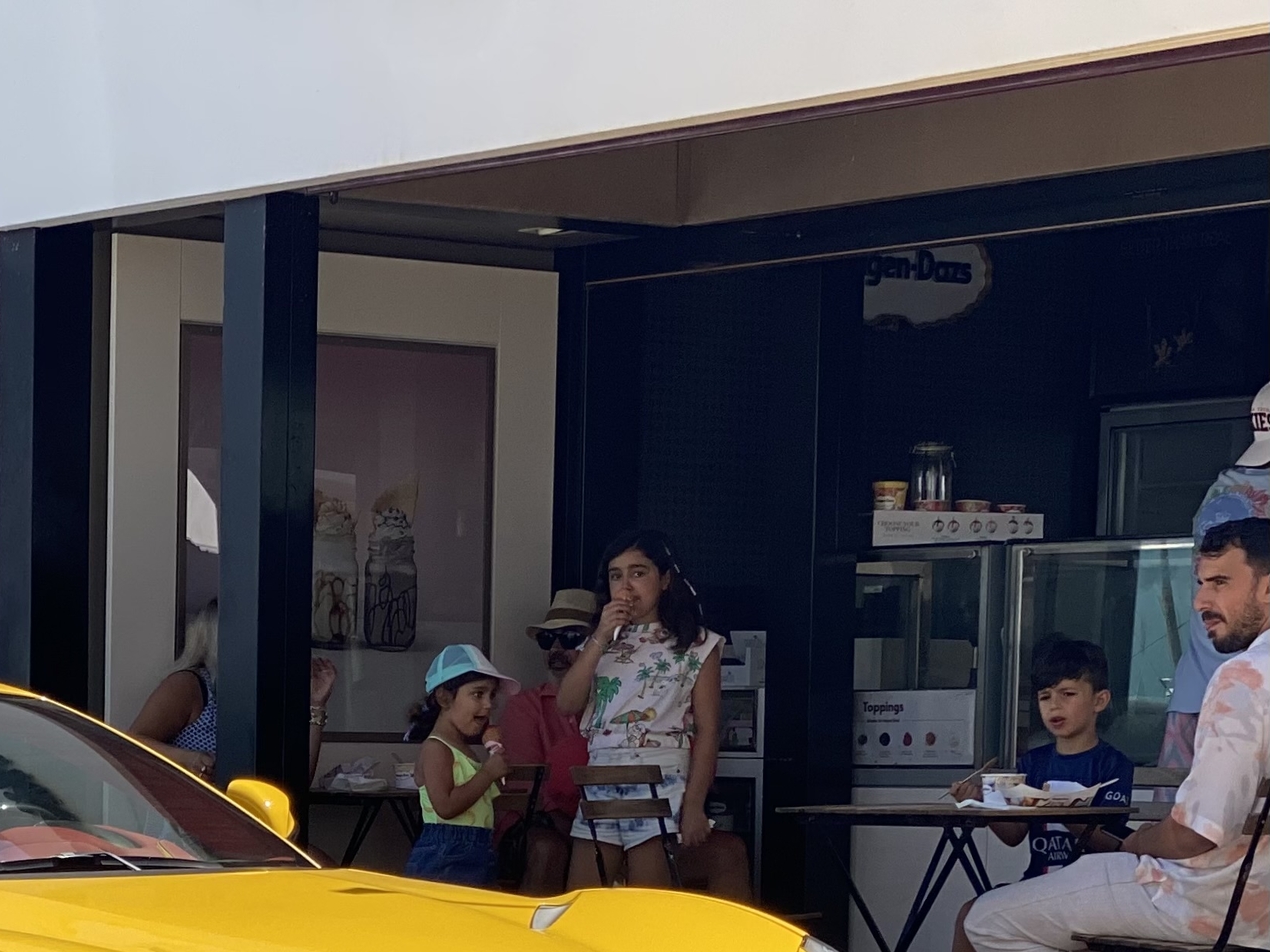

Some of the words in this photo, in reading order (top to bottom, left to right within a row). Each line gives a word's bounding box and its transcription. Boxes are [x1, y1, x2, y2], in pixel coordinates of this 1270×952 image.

[863, 701, 904, 715] Toppings
[1104, 790, 1129, 806] GOA
[1032, 836, 1073, 854] QATA
[1048, 851, 1069, 861] AIRW
